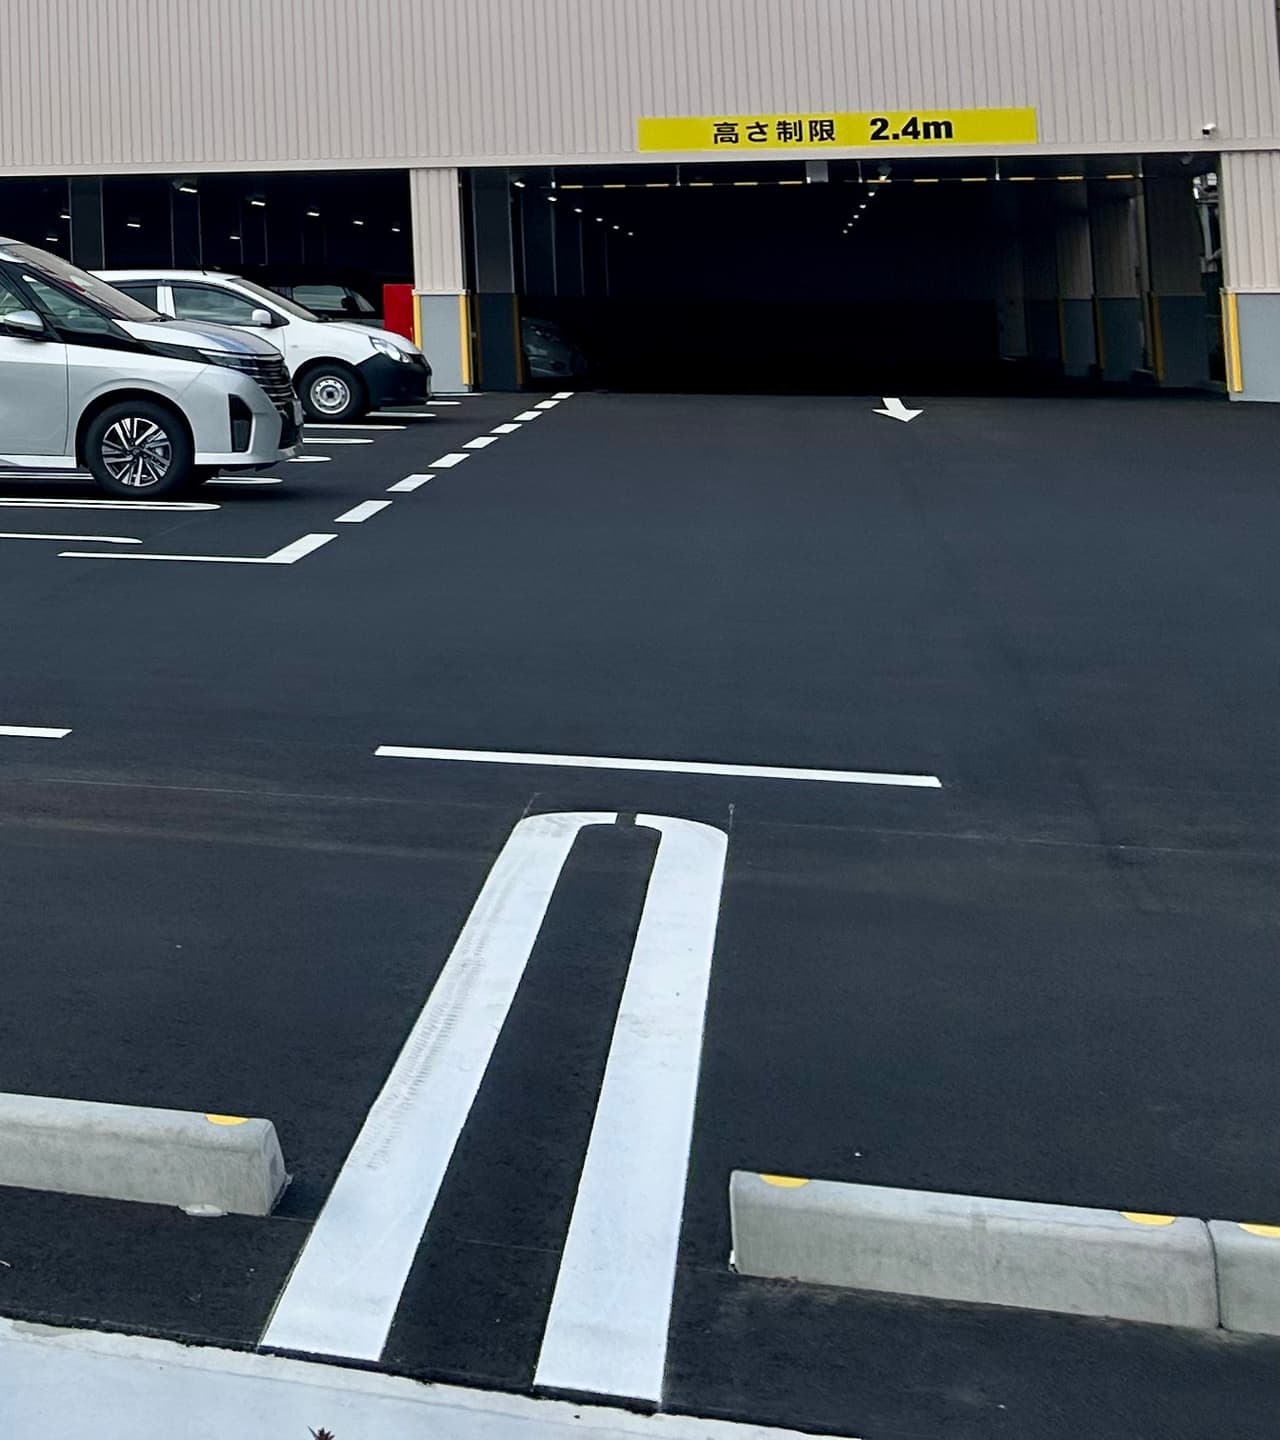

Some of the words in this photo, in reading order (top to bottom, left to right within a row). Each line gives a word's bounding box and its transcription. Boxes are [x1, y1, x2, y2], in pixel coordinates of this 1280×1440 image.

[712, 119, 836, 145] 高さ制限
[869, 117, 953, 141] 2.4m
